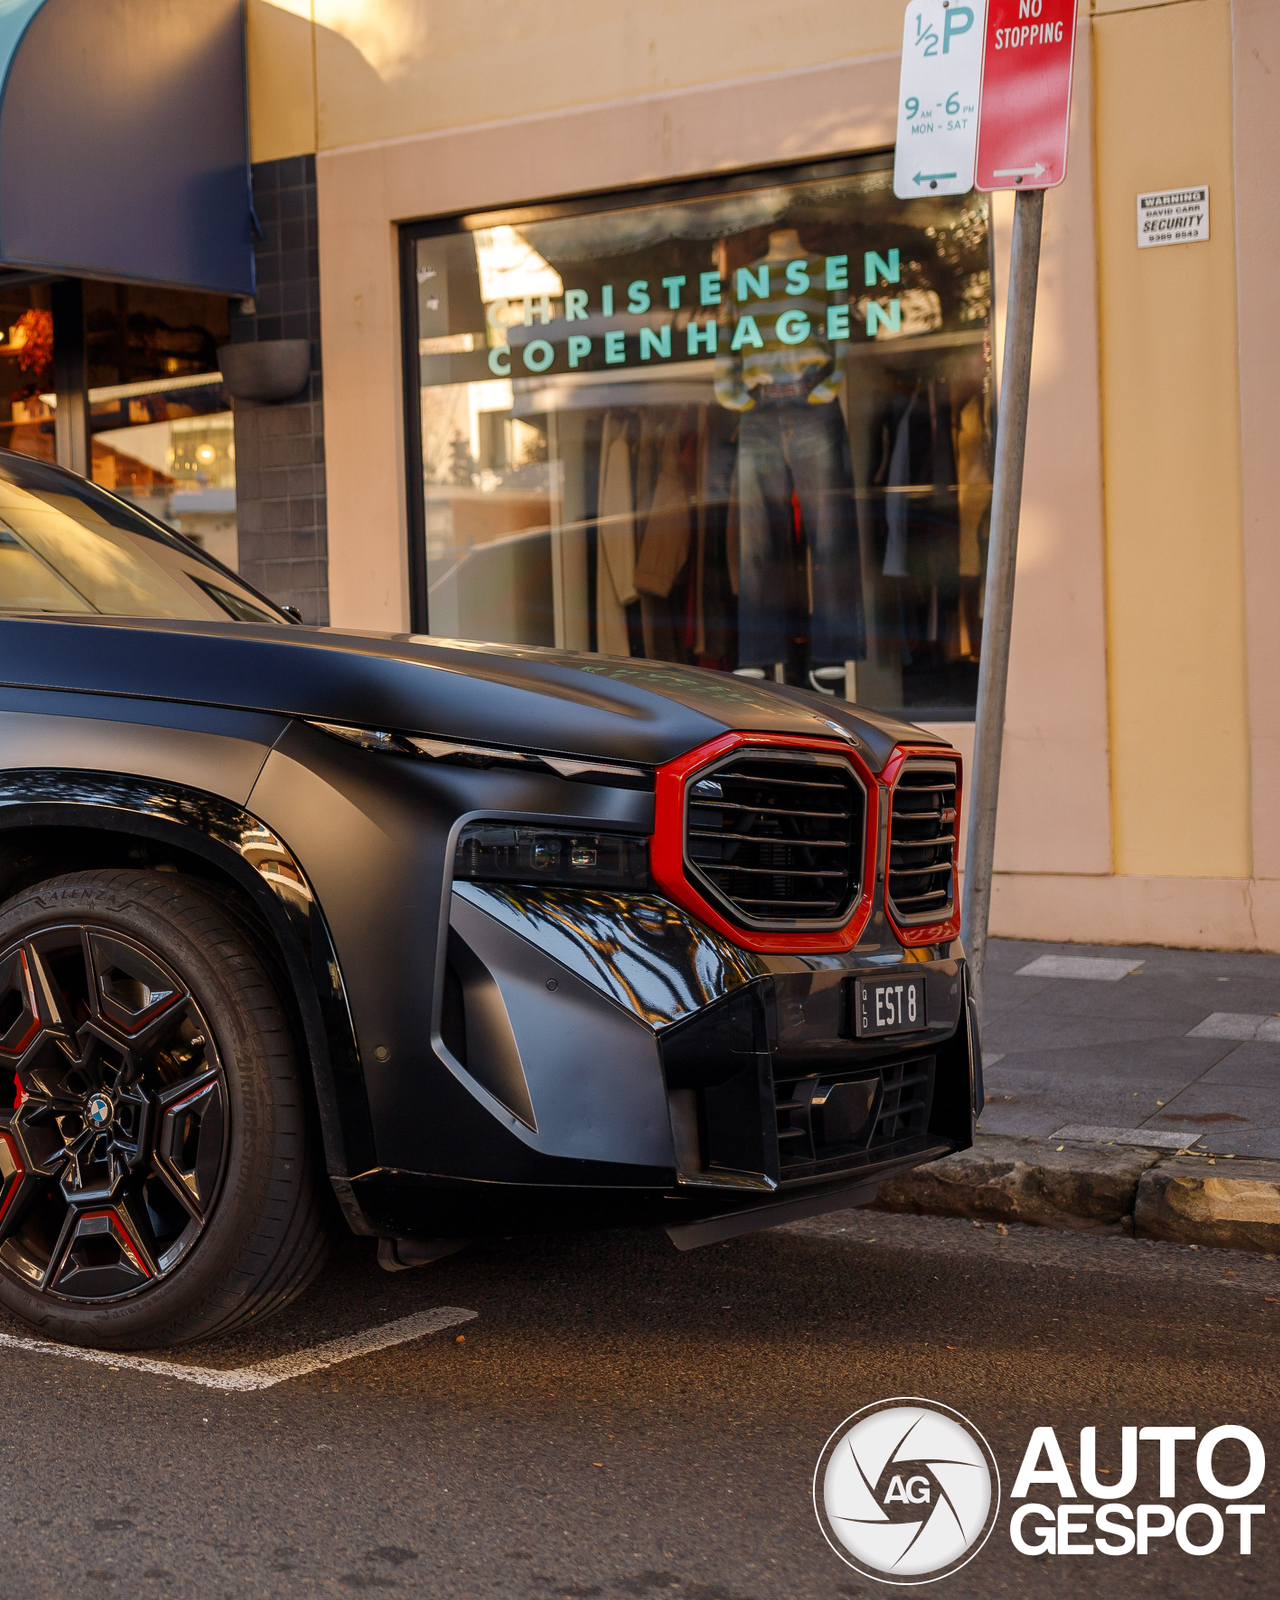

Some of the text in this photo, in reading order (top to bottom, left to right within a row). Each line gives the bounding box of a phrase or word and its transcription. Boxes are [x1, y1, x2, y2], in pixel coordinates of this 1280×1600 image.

[1018, 0, 1042, 19] NO
[994, 21, 1064, 50] STOPPING
[911, 123, 934, 135] MON
[947, 119, 968, 132] SAT
[1144, 191, 1201, 207] WARNING
[1146, 208, 1173, 218] DAVID
[1143, 213, 1204, 233] SECURITY
[487, 248, 901, 328] CHRISTENSEN
[487, 299, 902, 377] COPENHAGEN
[48, 888, 116, 904] ALENZA
[875, 984, 917, 1027] EST 8
